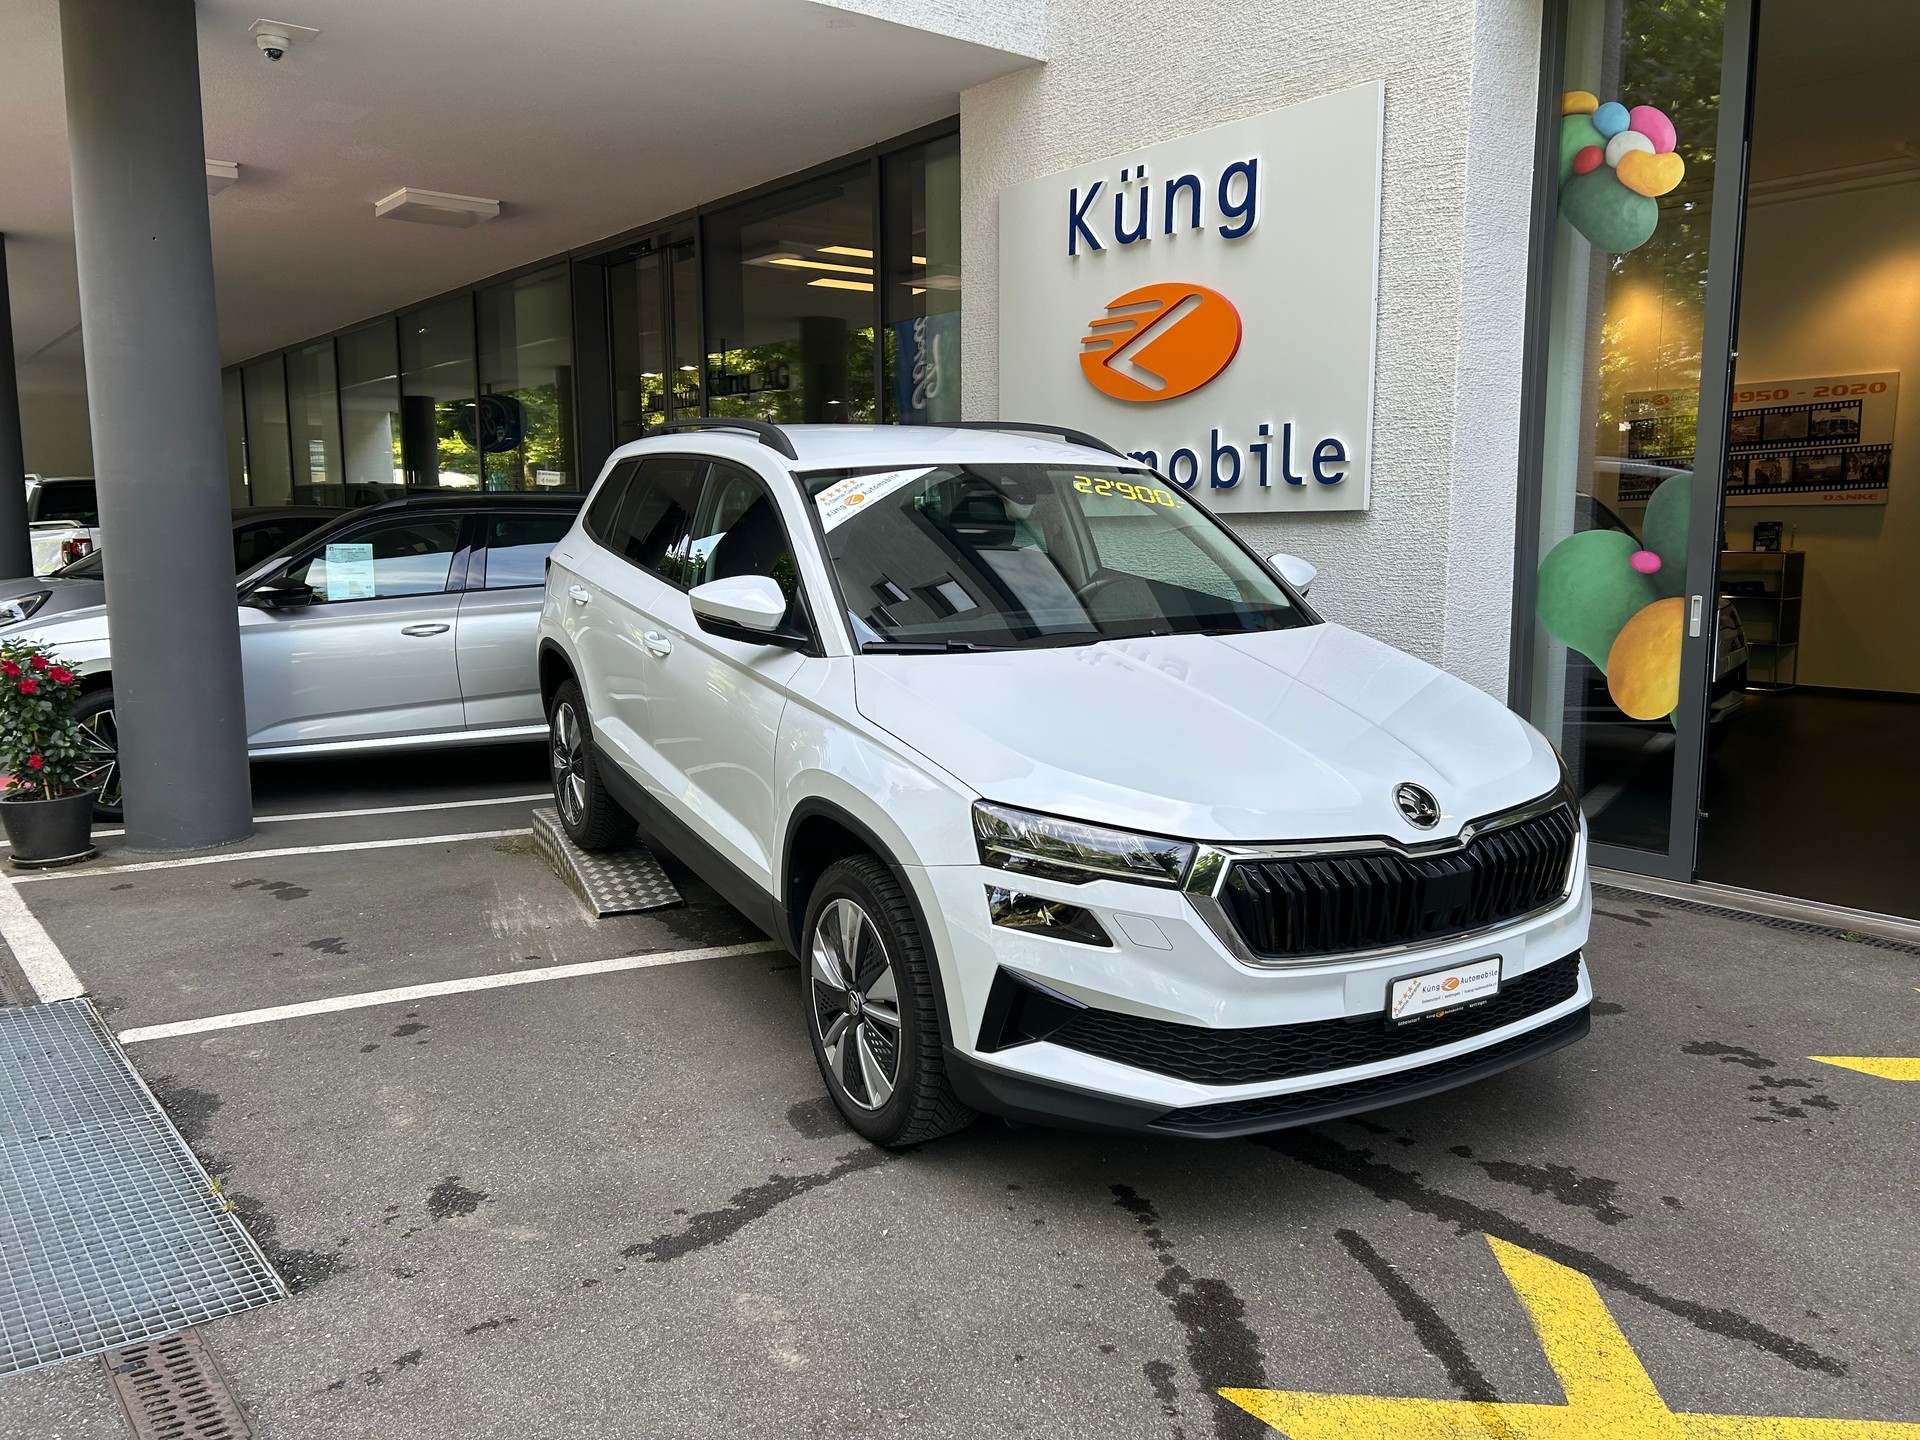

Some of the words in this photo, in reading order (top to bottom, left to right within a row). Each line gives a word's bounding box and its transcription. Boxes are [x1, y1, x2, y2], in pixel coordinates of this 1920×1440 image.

[1068, 156, 1261, 257] Küng
[1733, 388, 1790, 403] 1950
[1813, 381, 1888, 399] 2020
[825, 504, 847, 517] Küng
[863, 473, 900, 495] Automobile
[1823, 493, 1879, 502] DANKE
[1422, 984, 1440, 993] Küng
[1461, 970, 1498, 983] Automobile
